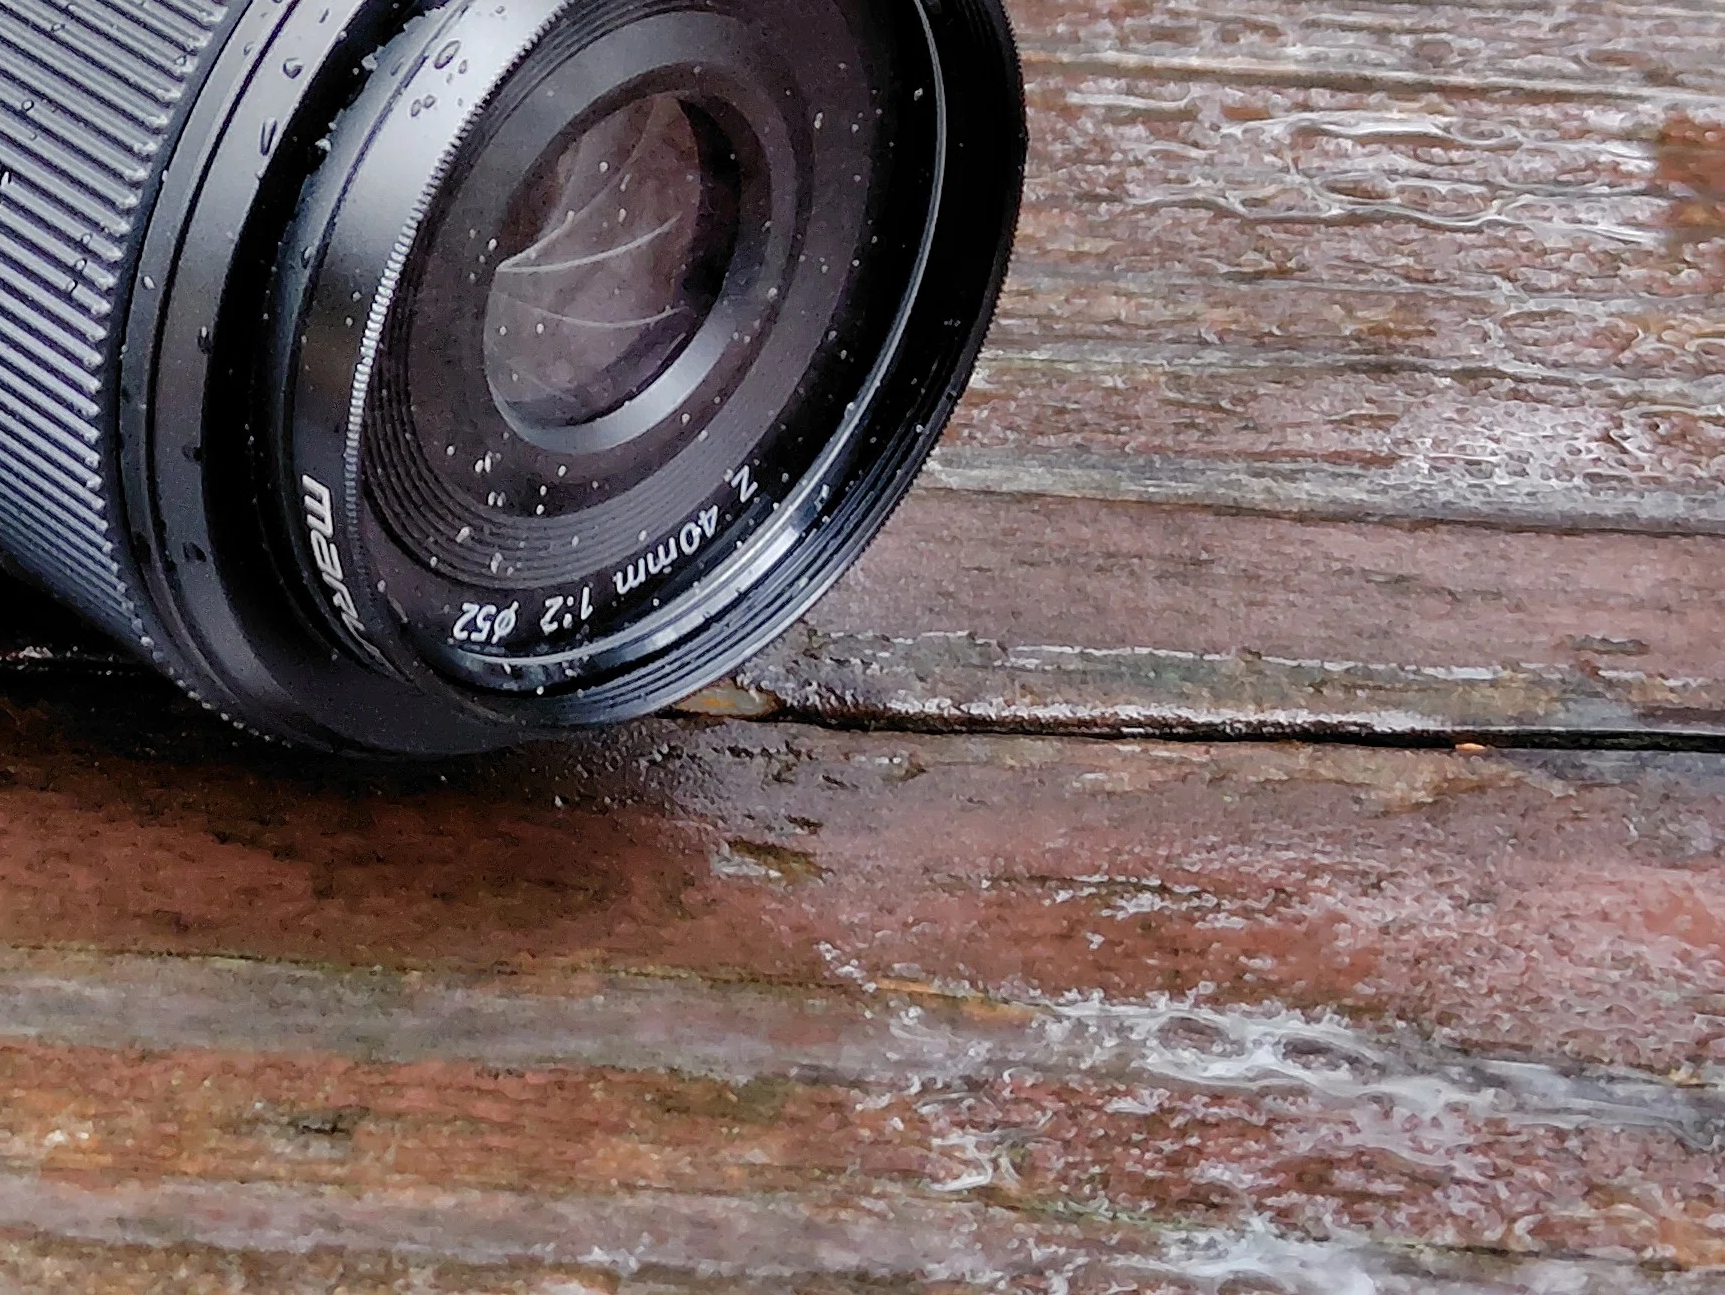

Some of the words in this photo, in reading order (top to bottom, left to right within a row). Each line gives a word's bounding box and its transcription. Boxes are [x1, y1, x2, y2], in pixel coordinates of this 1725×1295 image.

[731, 464, 758, 503] Z
[612, 504, 719, 596] 40mm
[540, 584, 593, 634] 1:2
